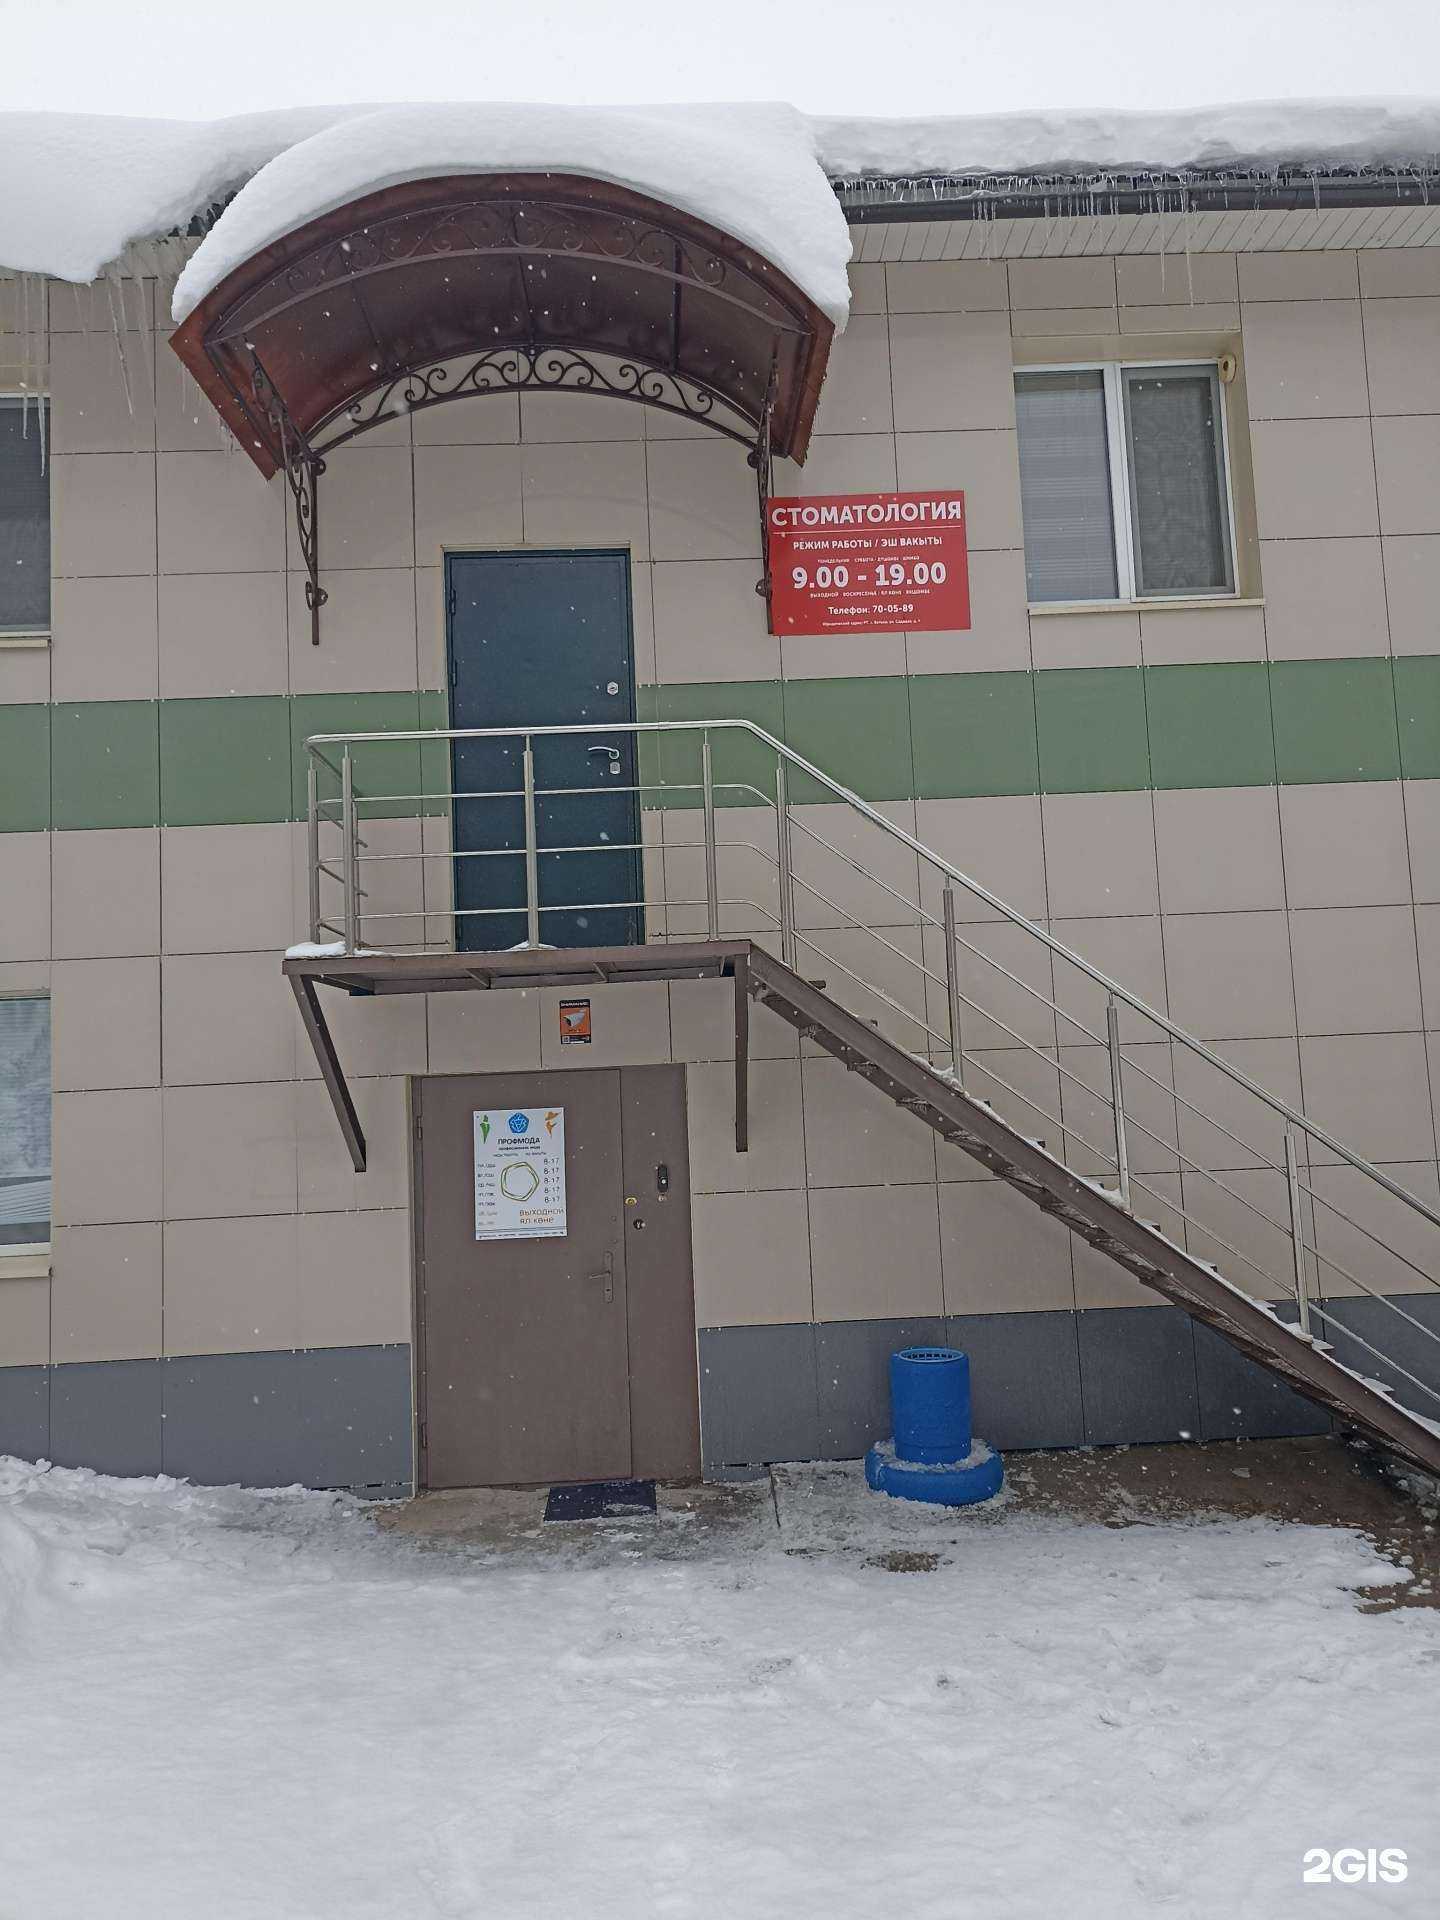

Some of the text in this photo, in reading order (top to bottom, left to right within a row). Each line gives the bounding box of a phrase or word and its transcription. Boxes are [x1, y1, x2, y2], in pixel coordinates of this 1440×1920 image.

[771, 500, 961, 526] СТОМАТОЛОГИЯ
[793, 540, 830, 550] РЕЖИМ
[832, 539, 872, 549] РАБОТЫ
[881, 537, 897, 547] ЭШ
[900, 536, 943, 546] ВАКЫТЫ
[792, 565, 849, 589] 9.00
[874, 562, 946, 586] 19.00
[828, 604, 914, 616] Телефон: 70-05-89
[497, 1137, 541, 1145] ПРОФМОДА
[519, 1207, 564, 1216] ВЫХОДНОЙ
